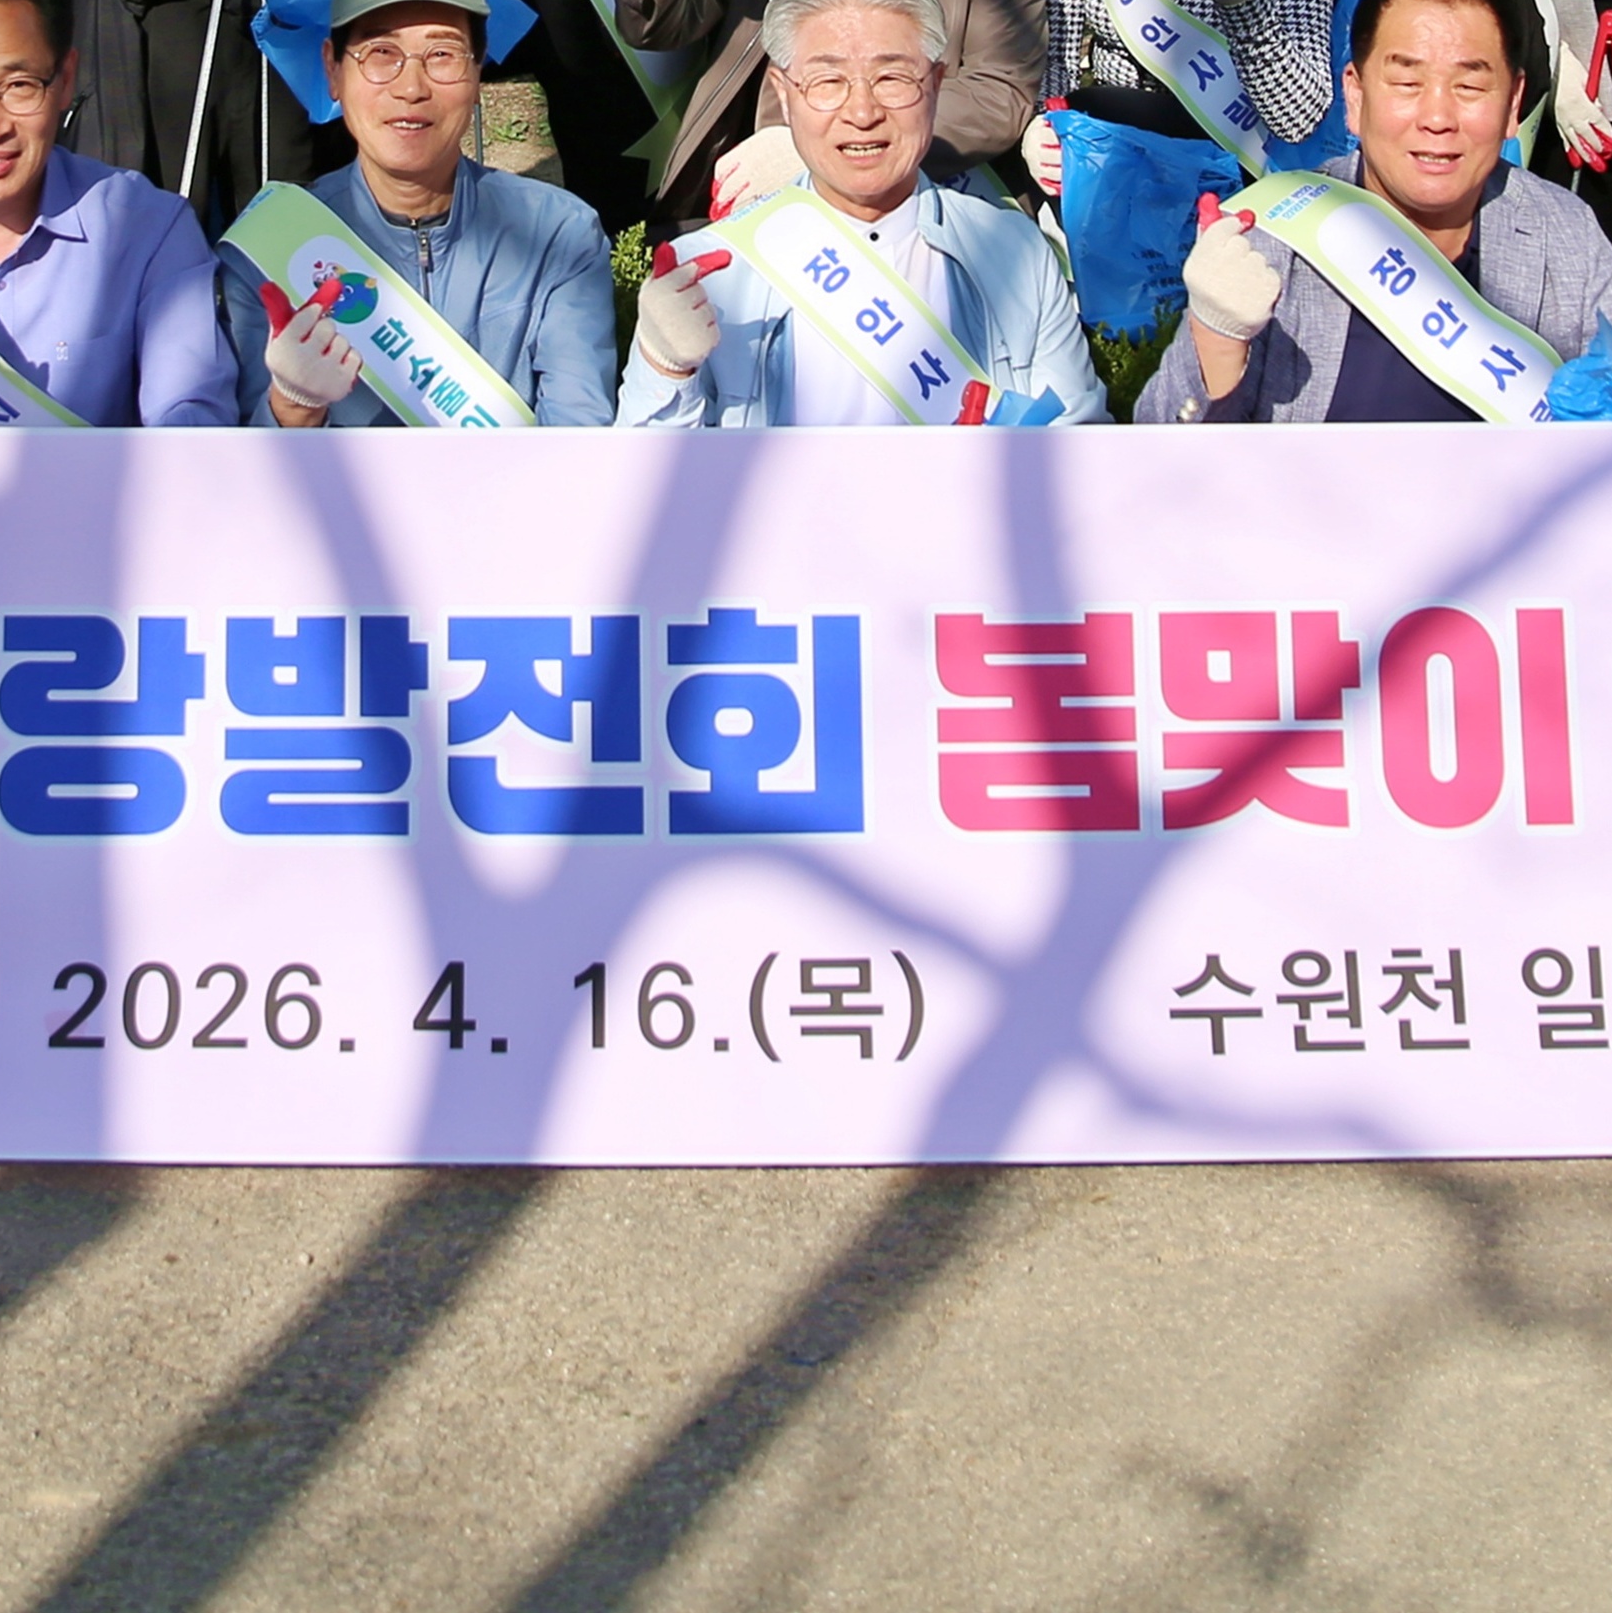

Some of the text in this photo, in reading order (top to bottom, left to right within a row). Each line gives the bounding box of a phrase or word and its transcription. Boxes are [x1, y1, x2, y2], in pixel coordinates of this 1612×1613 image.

[933, 604, 1575, 832] 봄맞이
[47, 949, 925, 1062] 2026. 4. 16.(목)
[1168, 945, 1471, 1056] 수원천
